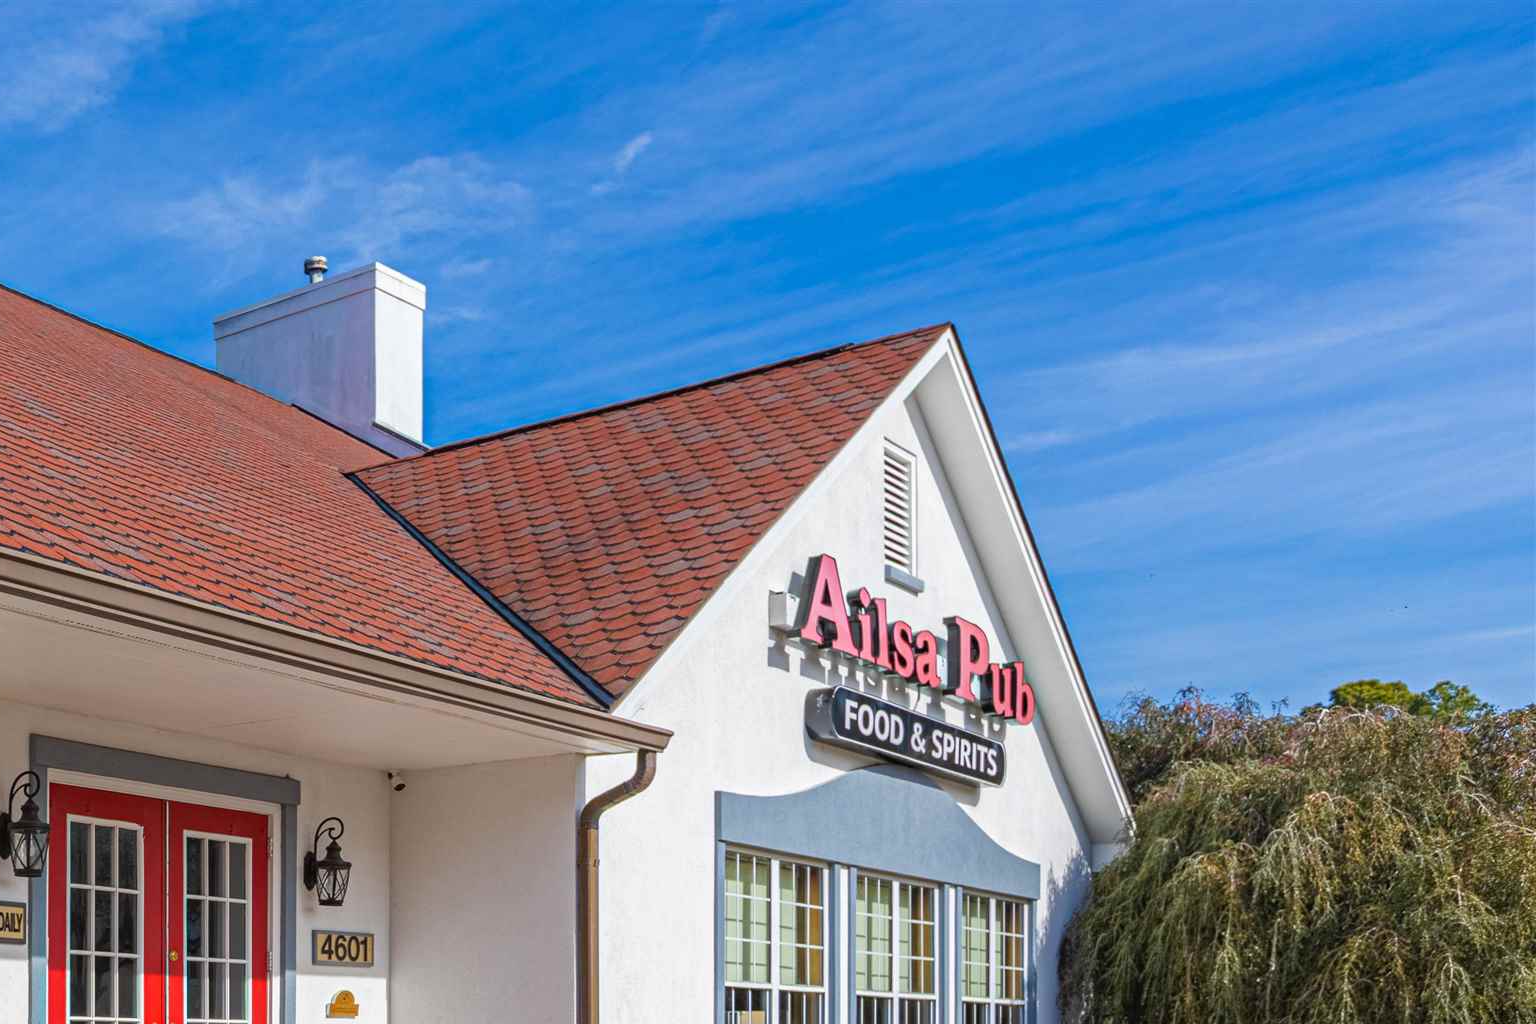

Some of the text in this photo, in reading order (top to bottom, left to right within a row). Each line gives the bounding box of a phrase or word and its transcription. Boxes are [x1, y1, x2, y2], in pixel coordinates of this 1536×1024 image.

[801, 553, 1036, 726] Ailsa Pub
[843, 698, 998, 777] FOOD & SPIRITS
[321, 934, 368, 962] 4601
